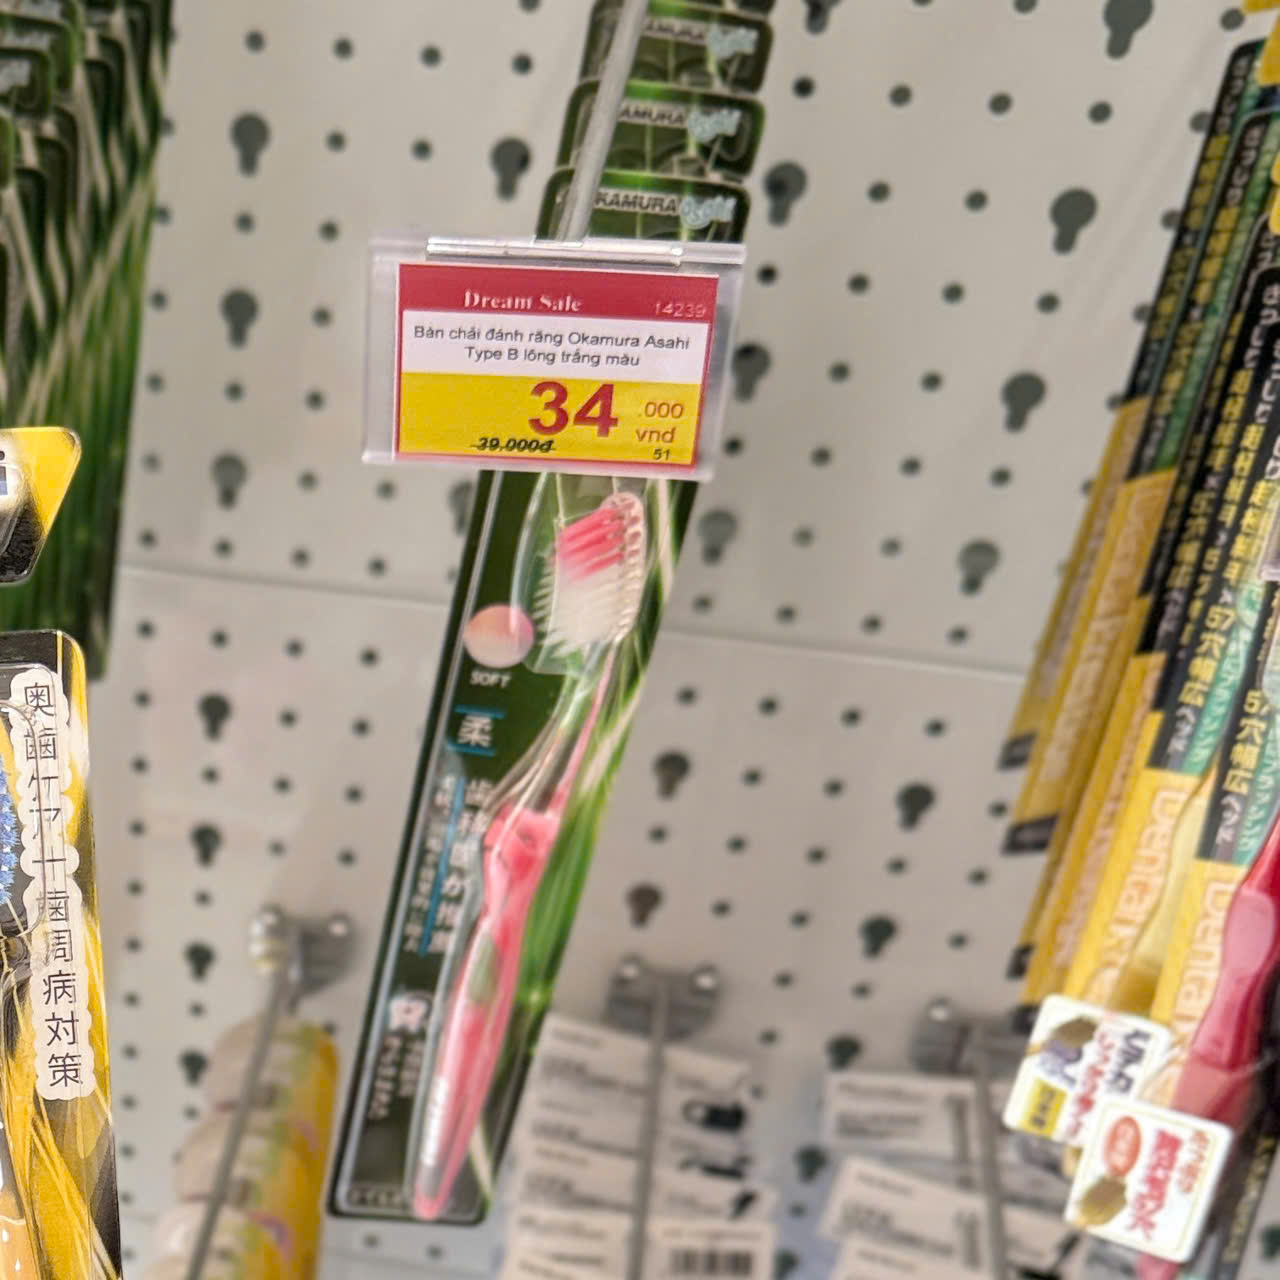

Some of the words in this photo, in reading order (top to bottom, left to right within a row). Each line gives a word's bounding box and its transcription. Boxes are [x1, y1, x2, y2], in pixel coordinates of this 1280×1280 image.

[595, 189, 677, 214] KAMURA
[464, 289, 532, 312] Dream
[540, 296, 583, 313] Sale
[414, 324, 445, 339] Bàn
[449, 326, 481, 341] chải
[485, 328, 523, 343] đánh
[528, 331, 563, 347] răng
[568, 331, 640, 349] Okamura
[644, 335, 690, 350] Asahi
[465, 346, 503, 362] Type
[507, 348, 519, 361] B
[523, 349, 556, 366] lông
[605, 353, 641, 368] màu
[528, 381, 618, 438] 34
[638, 402, 685, 419] .000
[635, 425, 676, 444] vnd
[653, 448, 671, 461] 51
[471, 670, 512, 689] SOFT
